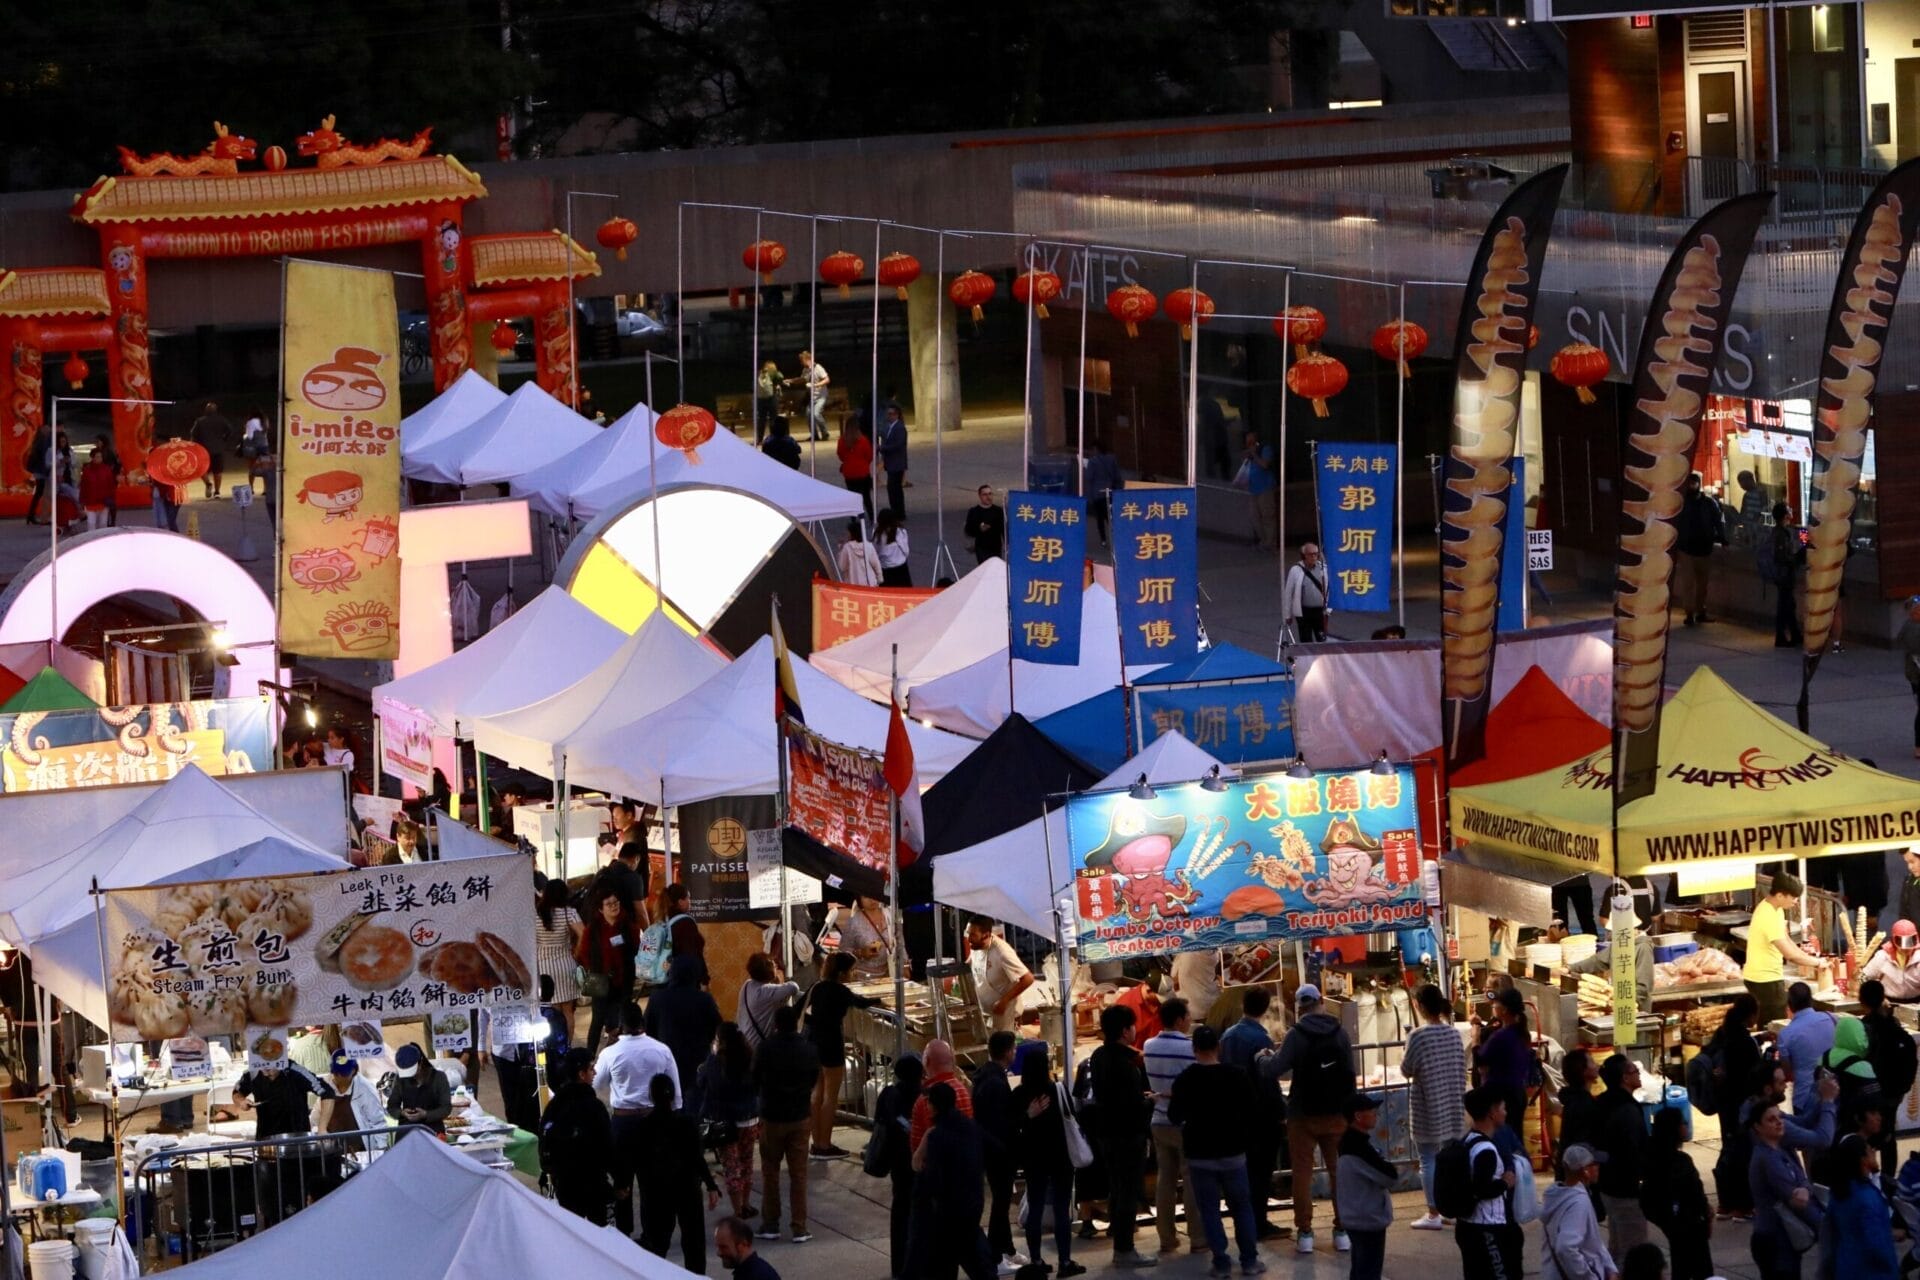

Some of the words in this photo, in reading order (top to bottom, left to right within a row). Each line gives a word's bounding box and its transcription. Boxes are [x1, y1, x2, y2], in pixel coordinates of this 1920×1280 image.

[167, 231, 242, 254] TORONTO
[250, 228, 314, 251] DRAGON
[321, 219, 408, 246] FESTIVAL
[1325, 454, 1389, 475] 羊肉串
[1016, 503, 1080, 526] 羊肉串
[1120, 501, 1188, 521] 羊肉串
[1338, 485, 1376, 596] 郭师傅
[1530, 532, 1550, 544] HES
[1530, 556, 1550, 568] SAS
[1022, 535, 1064, 648] 郭师傅
[1135, 532, 1177, 648] 郭师傅
[1667, 762, 1766, 789] HAPPY
[1770, 752, 1839, 786] TWIST
[1387, 831, 1414, 840] Sale
[1462, 806, 1600, 862] WWW.HAPPYTWISTINC.COM
[1646, 810, 1920, 863] WWW.HAPPYTWISTINC.CO
[691, 862, 749, 873] PATISSE
[1081, 868, 1106, 877] Sale
[341, 878, 373, 895] Leek
[380, 873, 405, 888] Pie
[1286, 905, 1368, 930] Teriyaki
[1371, 901, 1424, 921] Squid
[414, 927, 434, 942] 和
[1095, 922, 1147, 939] Jumbo
[1152, 916, 1221, 933] Octopus
[152, 929, 291, 972] 生煎包
[1107, 935, 1182, 955] Tentacle
[153, 978, 204, 994] Steam
[214, 974, 244, 990] Fry
[256, 970, 287, 985] Bun
[331, 983, 448, 1016] 牛肉餡餅
[449, 991, 485, 1006] Beef
[494, 988, 522, 1001] Pie
